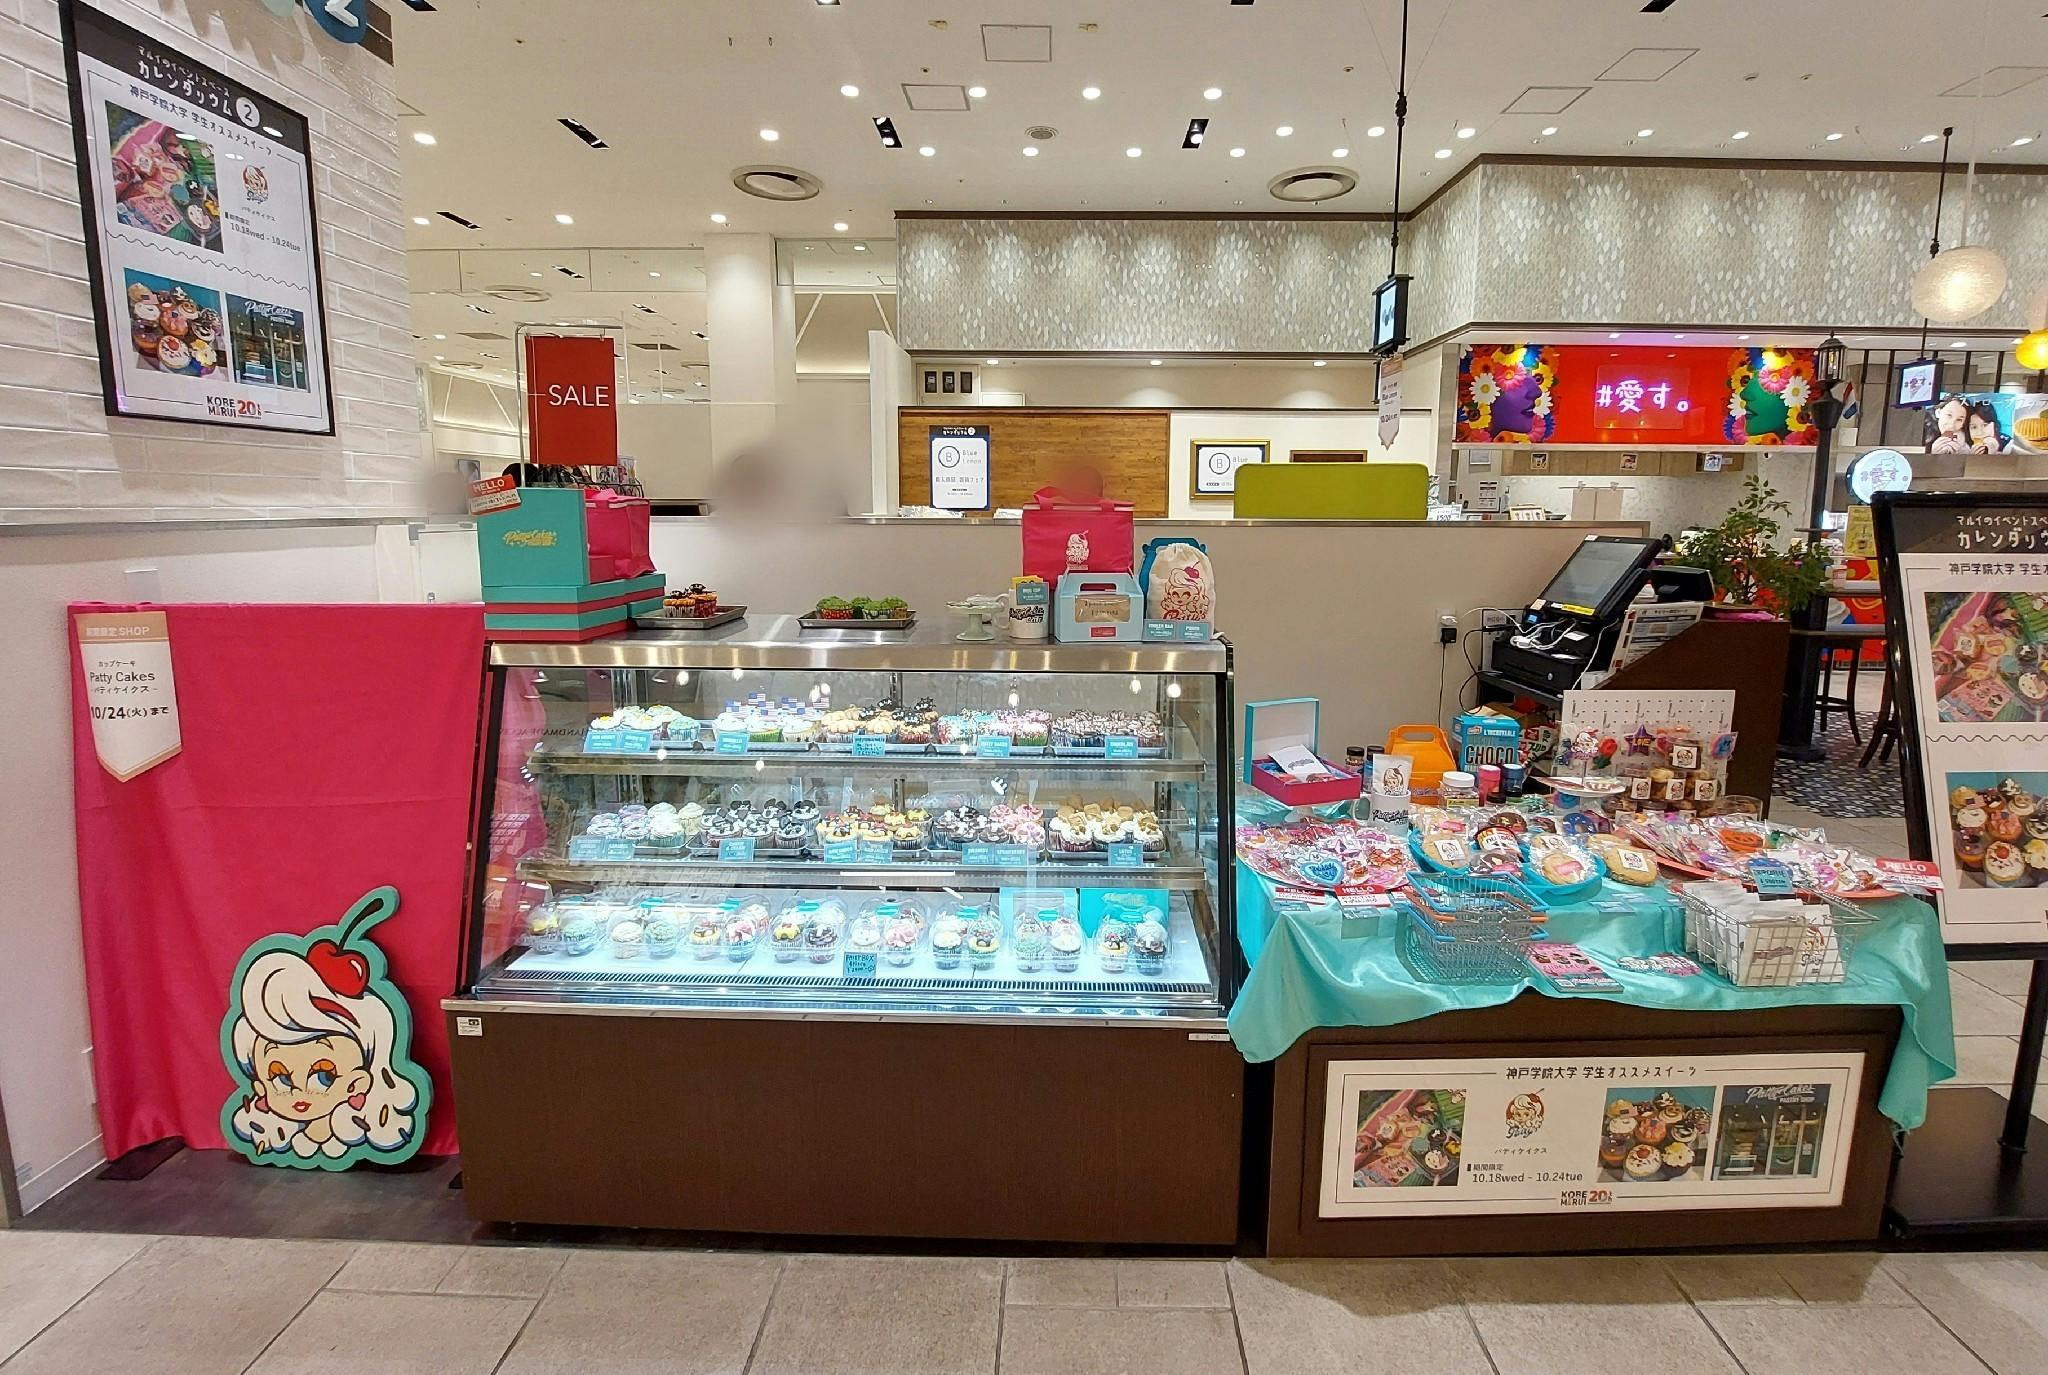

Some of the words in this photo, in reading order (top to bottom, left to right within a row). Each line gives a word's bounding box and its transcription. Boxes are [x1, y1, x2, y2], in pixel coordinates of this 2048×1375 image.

[138, 60, 233, 117] カレンダリウム
[130, 84, 188, 118] 神戸学院大学
[206, 395, 236, 408] KOBE
[549, 384, 610, 408] SALE
[472, 479, 506, 493] HELLO
[1949, 563, 2015, 576] 神戸学院大学
[118, 626, 150, 636] SHOP
[90, 672, 113, 685] Patty
[115, 672, 155, 682] Cakes
[1632, 738, 1651, 746] LOVE
[1465, 746, 1514, 765] CHOCO
[1883, 860, 1926, 873] HELLO
[1342, 886, 1375, 894] HELLO
[1506, 1067, 1578, 1080] 神戸学院大学
[1582, 1066, 1697, 1080] 学生オススメスイーツ
[1473, 1163, 1504, 1172] 期間限定
[1472, 1173, 1525, 1183] 10.18wed
[1536, 1172, 1583, 1182] 10.24tue
[1561, 1190, 1588, 1199] KOBE
